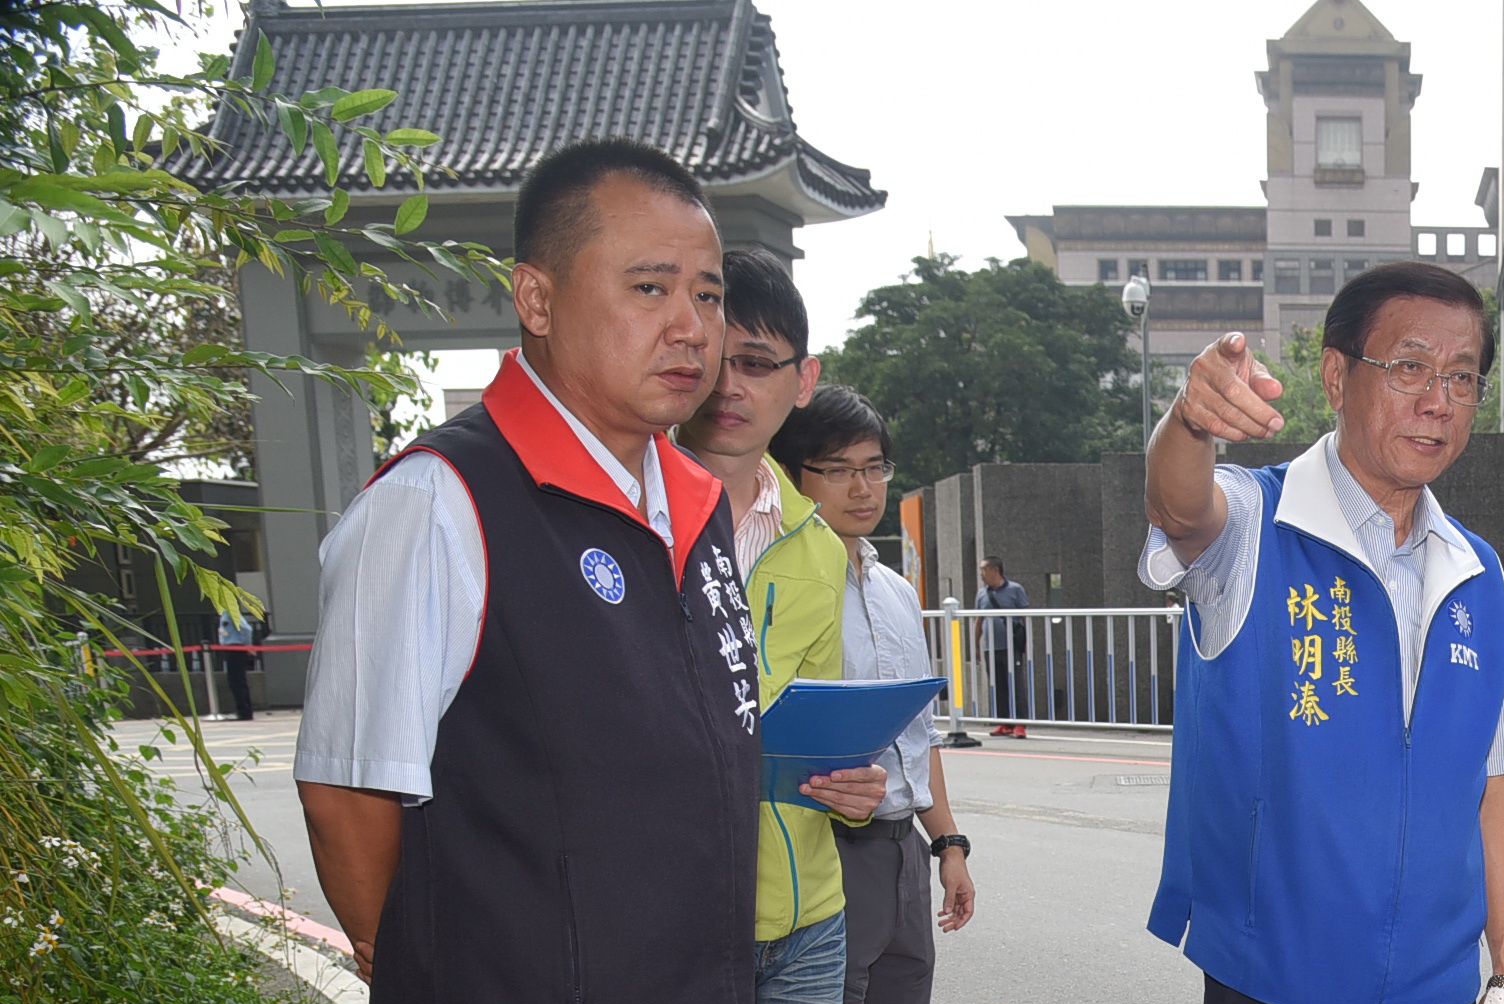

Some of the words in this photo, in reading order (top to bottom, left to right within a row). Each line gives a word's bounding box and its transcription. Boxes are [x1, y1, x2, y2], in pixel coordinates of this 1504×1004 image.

[711, 544, 761, 685] 南投縣
[1286, 583, 1330, 727] 林明溱
[1329, 575, 1359, 697] 南投縣長
[1450, 643, 1480, 671] KMT
